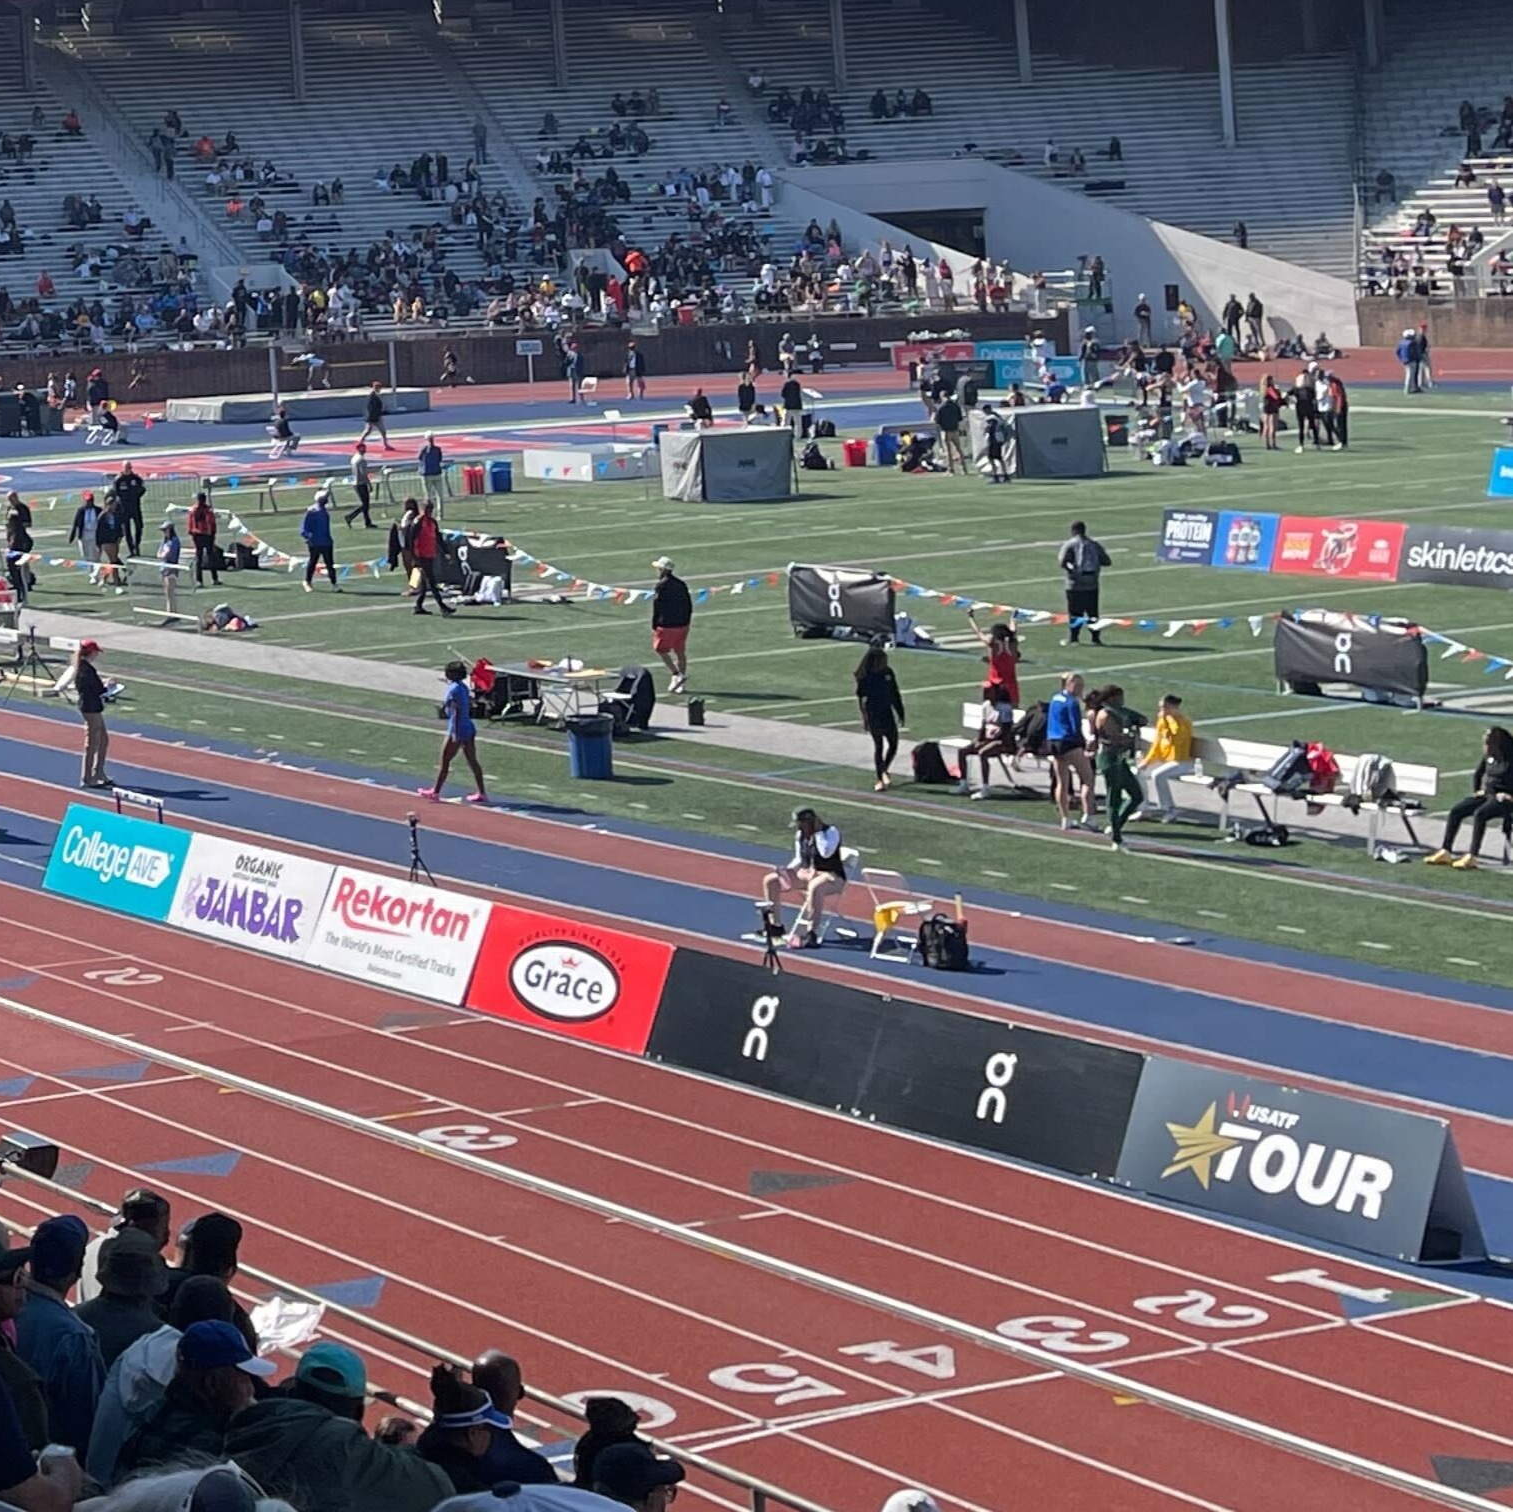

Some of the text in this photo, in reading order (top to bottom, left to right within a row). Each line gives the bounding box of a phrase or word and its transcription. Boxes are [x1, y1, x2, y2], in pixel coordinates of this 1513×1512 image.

[62, 825, 161, 884] College AVE
[235, 854, 284, 879] ORGANIC
[195, 876, 303, 944] JAMBAR
[332, 877, 470, 942] Rekortan
[326, 931, 340, 946] The
[341, 935, 371, 954] World's
[372, 943, 393, 960] Most
[430, 959, 456, 977] Tracks
[524, 959, 603, 1004] Grace
[1246, 1104, 1300, 1129] USATF
[1214, 1122, 1394, 1220] TOUR
[1266, 1267, 1393, 1303] 1
[1133, 1289, 1269, 1329] 2
[995, 1315, 1130, 1354] 3
[838, 1340, 956, 1380] 4
[707, 1362, 847, 1406] 5
